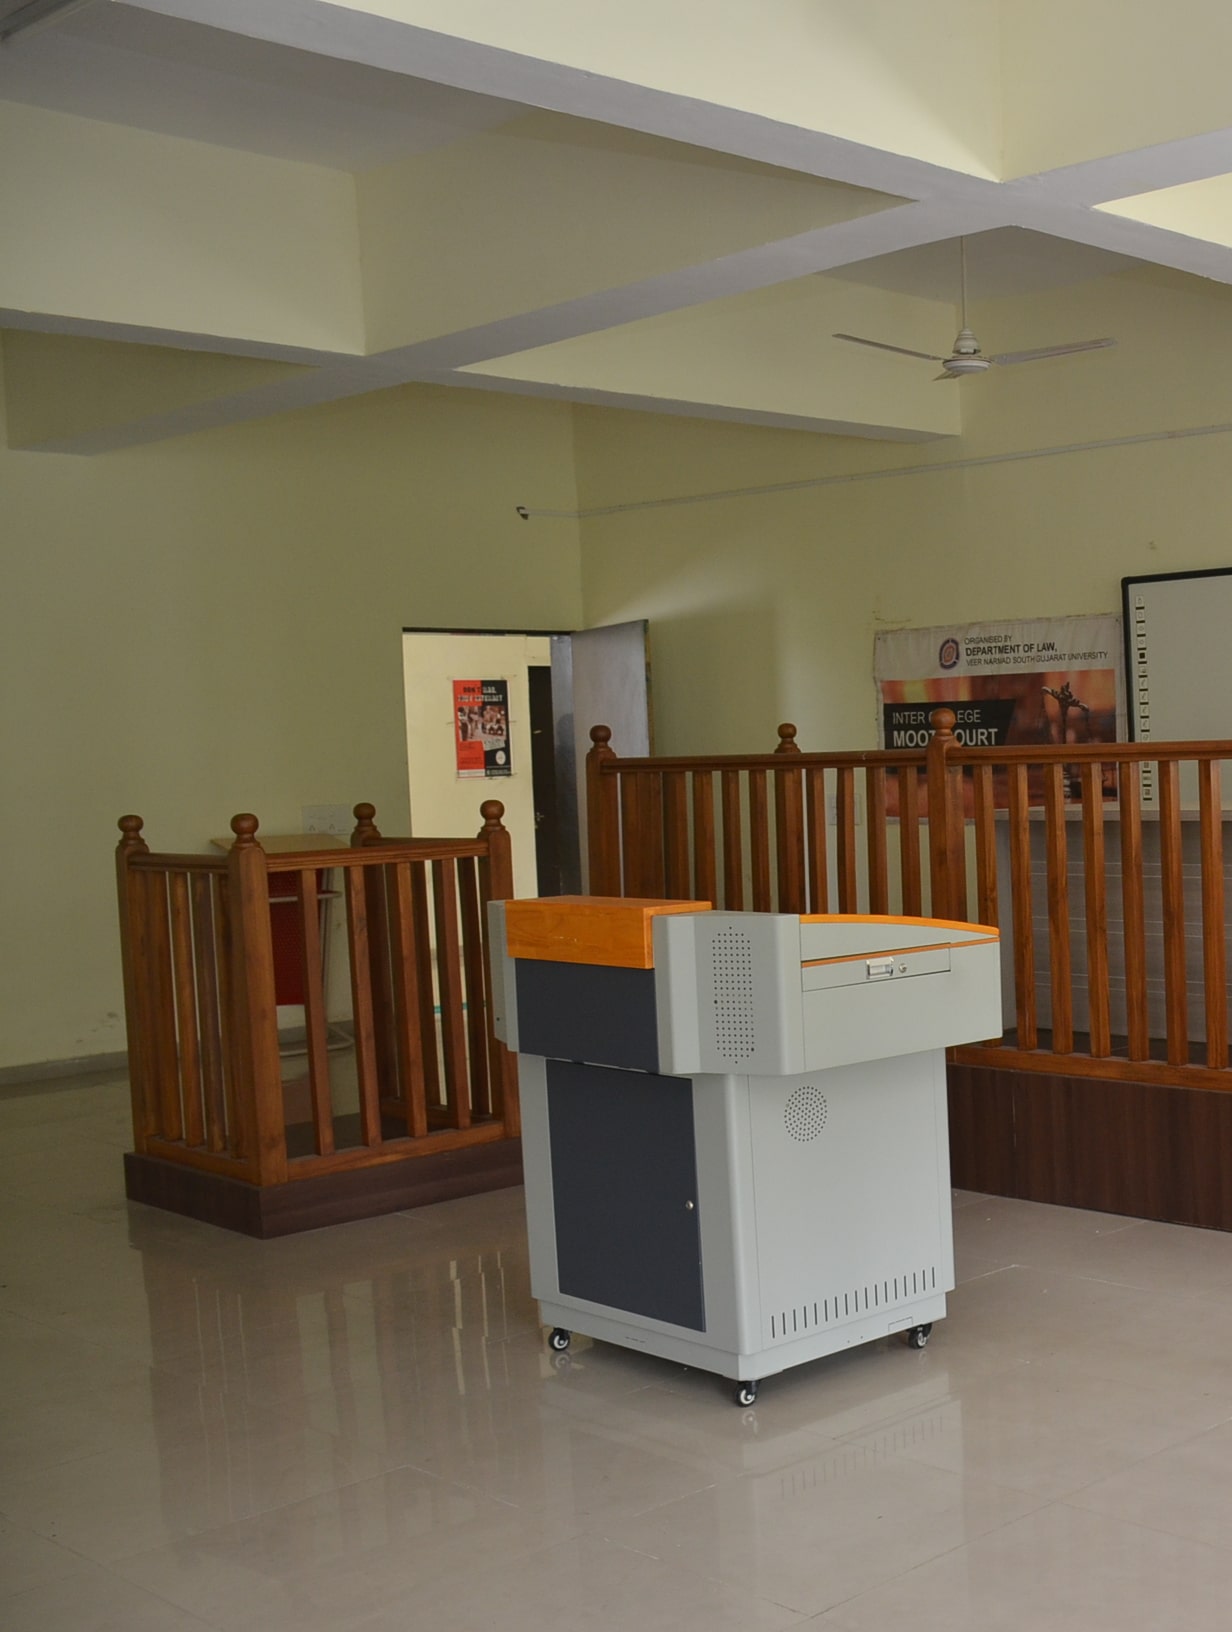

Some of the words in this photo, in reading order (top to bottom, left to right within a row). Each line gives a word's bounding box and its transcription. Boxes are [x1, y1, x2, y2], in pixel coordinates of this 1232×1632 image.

[964, 636, 1002, 645] ORGANISED
[1003, 635, 1013, 643] BY
[965, 644, 1021, 656] DEPARTMENT
[1023, 643, 1035, 653] OF
[966, 657, 983, 667] VEER
[983, 656, 1011, 665] NARMAD
[1012, 655, 1035, 664] SOUTH
[1036, 653, 1067, 663] GUJARAT
[1068, 651, 1108, 661] UNIVERSITY
[892, 712, 925, 724] INTER
[954, 728, 999, 746] OURT
